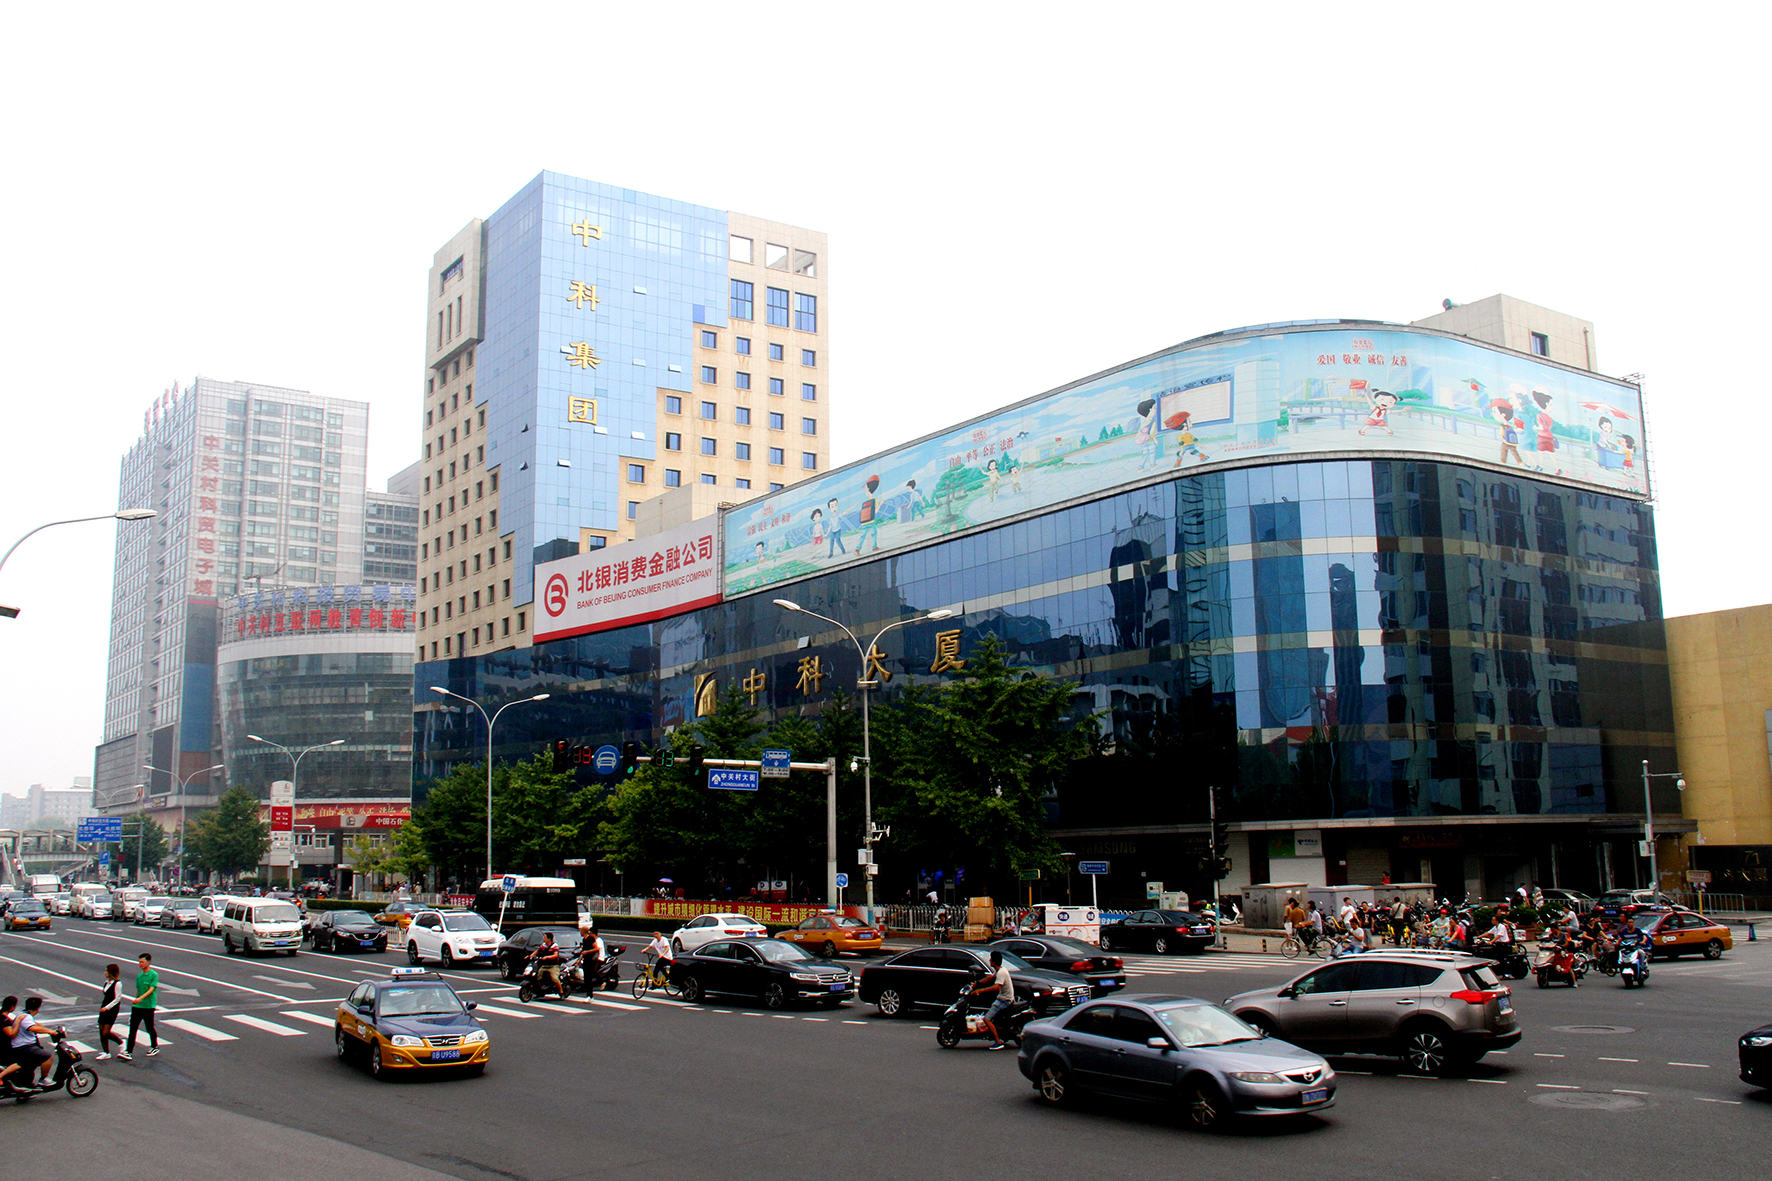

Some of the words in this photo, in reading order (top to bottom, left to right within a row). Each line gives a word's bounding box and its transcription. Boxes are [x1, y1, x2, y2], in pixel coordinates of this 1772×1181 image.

[566, 218, 602, 425] 中科集团
[1317, 354, 1336, 365] 爱国
[1343, 354, 1361, 365] 敬业
[1367, 354, 1385, 366] 诚信
[1391, 355, 1408, 367] 友善
[950, 455, 961, 469] 自由
[966, 449, 978, 463] 平等
[983, 443, 996, 457] 公正
[1000, 437, 1014, 451] 法治
[194, 434, 220, 596] 中关村科贸电子城
[577, 534, 713, 594] 北银消费金融公司
[577, 598, 594, 610] BANK
[594, 597, 602, 606] OF
[603, 591, 627, 604] BEIJING
[627, 582, 662, 598] CONSUMER
[662, 575, 686, 590] FINANCE
[686, 567, 713, 583] COMPANY
[237, 608, 416, 636] 中关村互联网教育创新
[742, 629, 968, 706] 中科大厦
[721, 772, 756, 781] 中关村大街
[376, 817, 404, 826] 中国石化
[1079, 842, 1137, 855] SAMSUNG
[653, 902, 732, 916] 提升城市精细化管理水平
